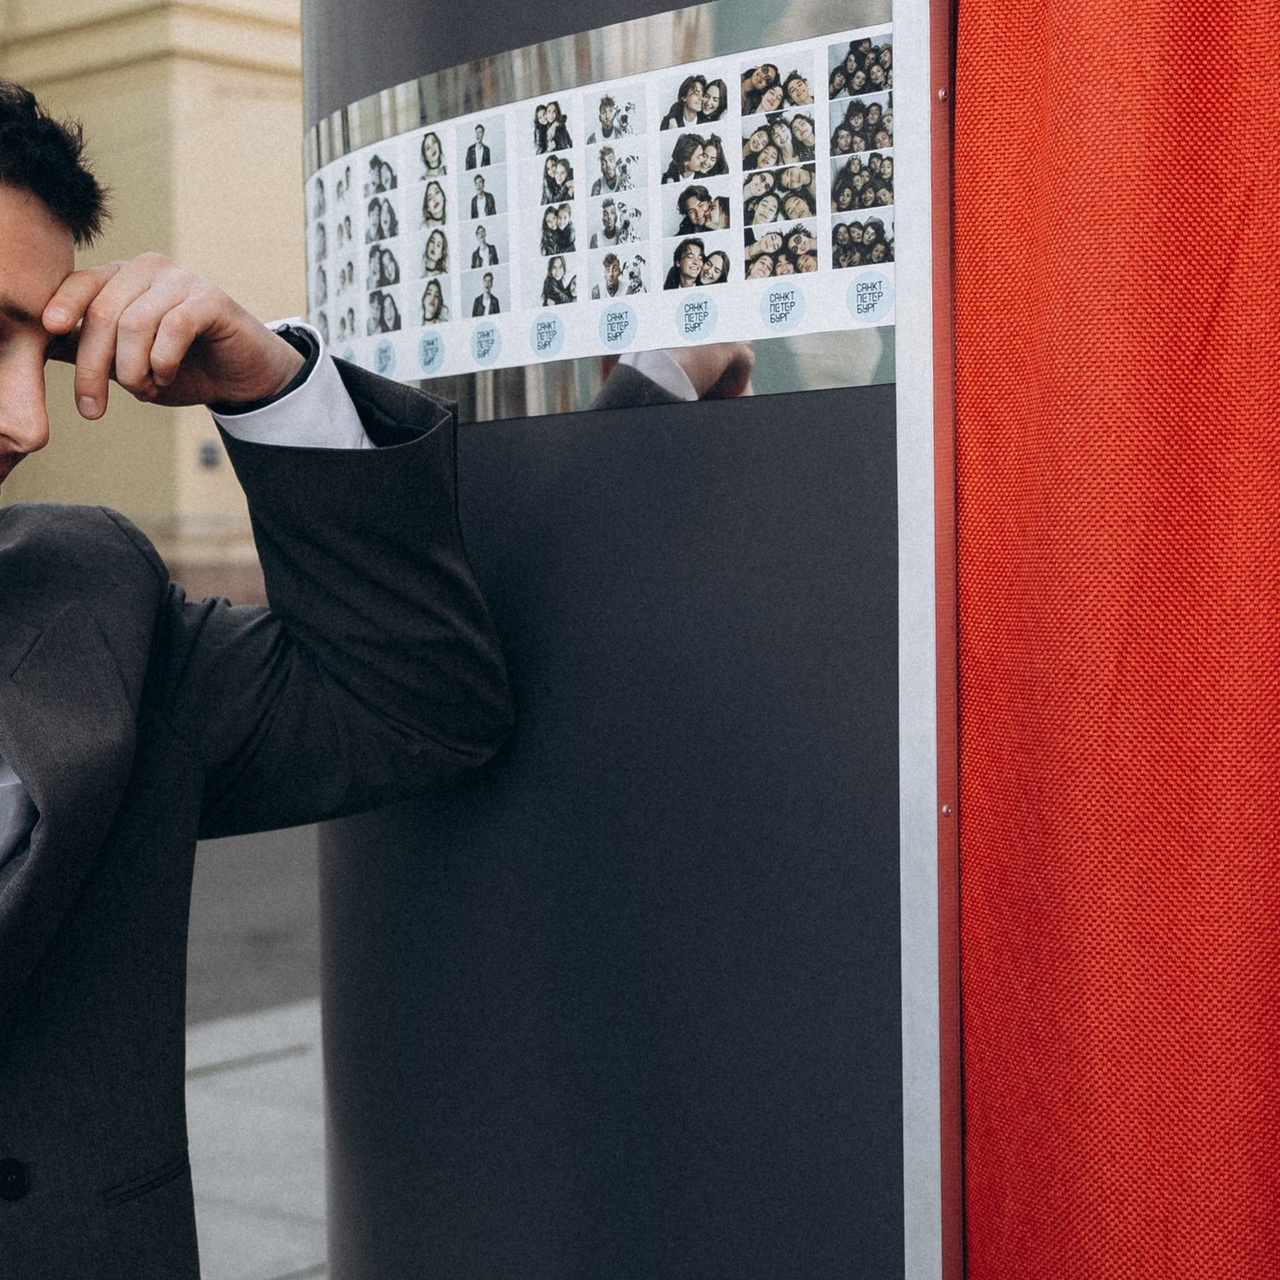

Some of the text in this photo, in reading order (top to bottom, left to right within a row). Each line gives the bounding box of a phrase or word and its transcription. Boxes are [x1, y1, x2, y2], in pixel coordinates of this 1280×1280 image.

[856, 281, 883, 292] САНКТ
[769, 291, 795, 302] САНКТ
[856, 291, 884, 303] ПЕТЕР
[684, 301, 708, 312] САНКТ
[769, 302, 796, 313] ПЕТЕР
[856, 302, 878, 314] БУРГ
[607, 311, 629, 322] САНКТ
[684, 311, 709, 322] ПЕТЕР
[770, 312, 790, 324] БУРГ
[607, 321, 629, 332] ПЕТЕР
[685, 322, 703, 333] БУРГ
[607, 331, 624, 342] БУРГ
